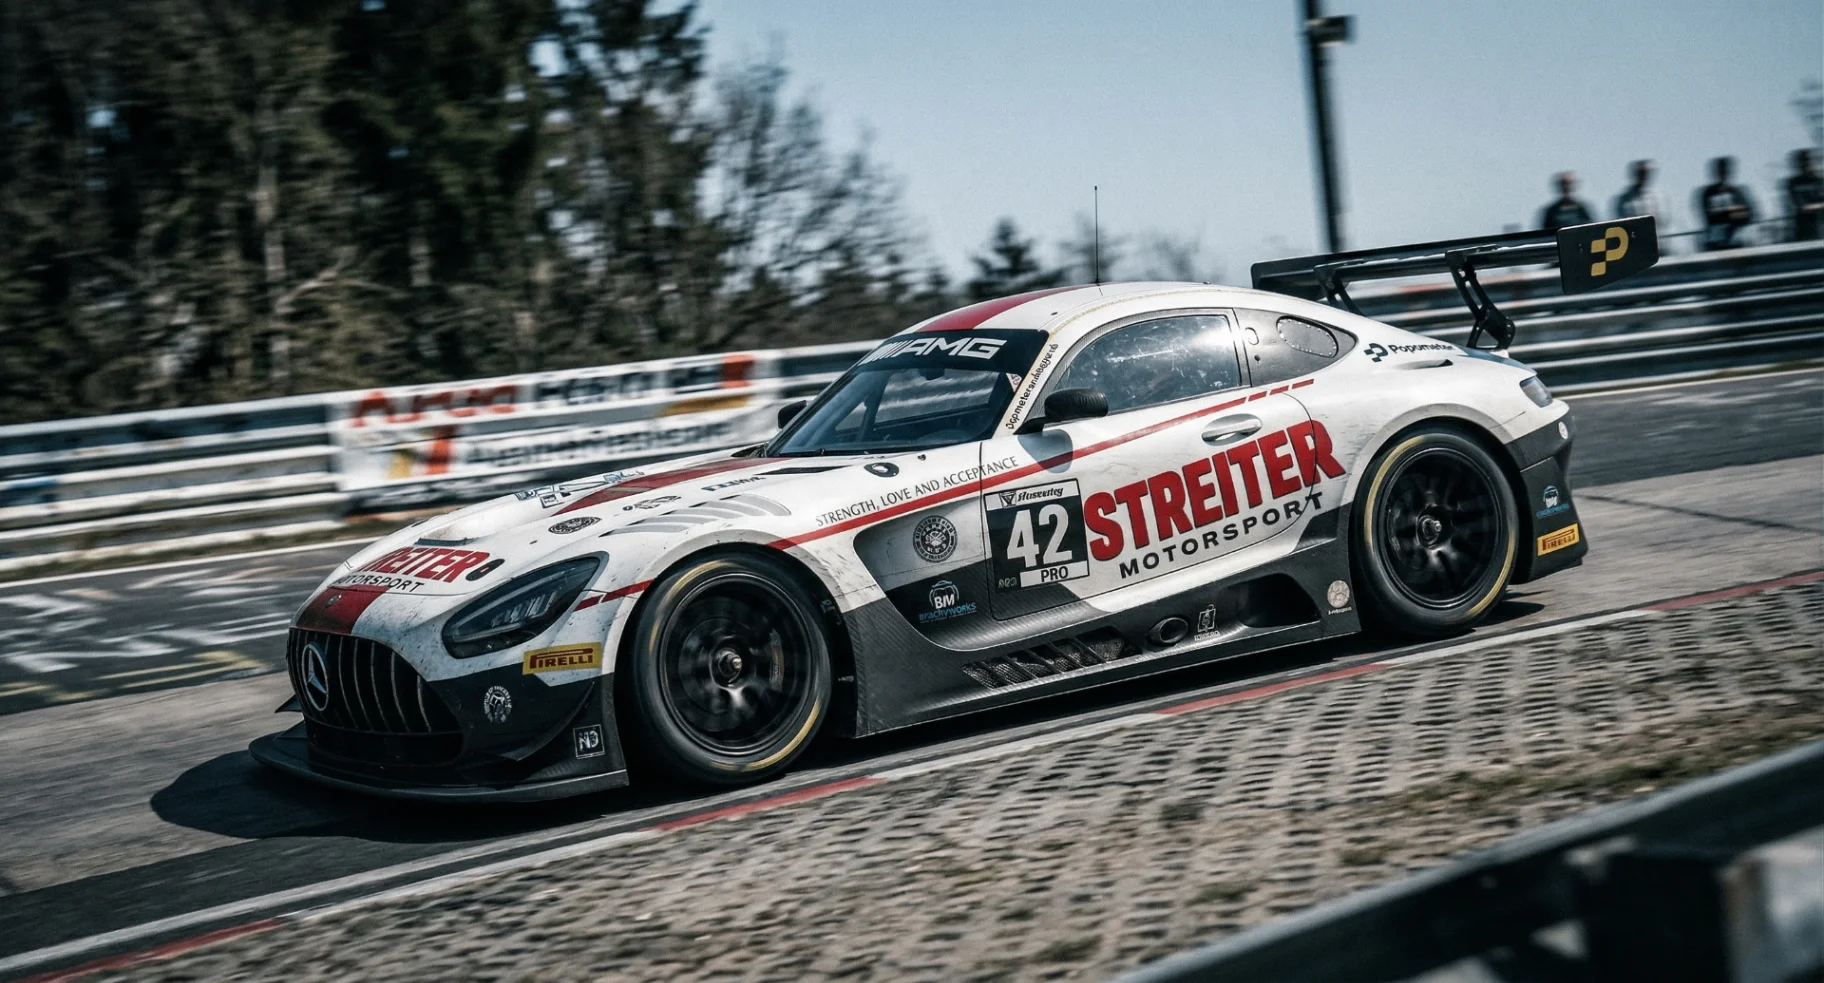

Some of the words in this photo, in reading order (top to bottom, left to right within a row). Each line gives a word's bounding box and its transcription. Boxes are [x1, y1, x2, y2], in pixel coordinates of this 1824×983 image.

[893, 337, 1008, 360] AMG
[815, 500, 880, 527] STRENGTH,
[882, 488, 912, 506] LOVE
[915, 479, 940, 497] AND
[943, 456, 1019, 488] ACCEPTANCE
[1083, 420, 1347, 561] STREITER
[1006, 504, 1073, 568] 42
[1119, 492, 1324, 579] MOTORSPORT
[1541, 528, 1576, 551] PIRELLI
[355, 547, 490, 583] REITER
[1040, 565, 1069, 582] PRO
[933, 594, 955, 610] BM
[529, 648, 593, 669] PIRELLI
